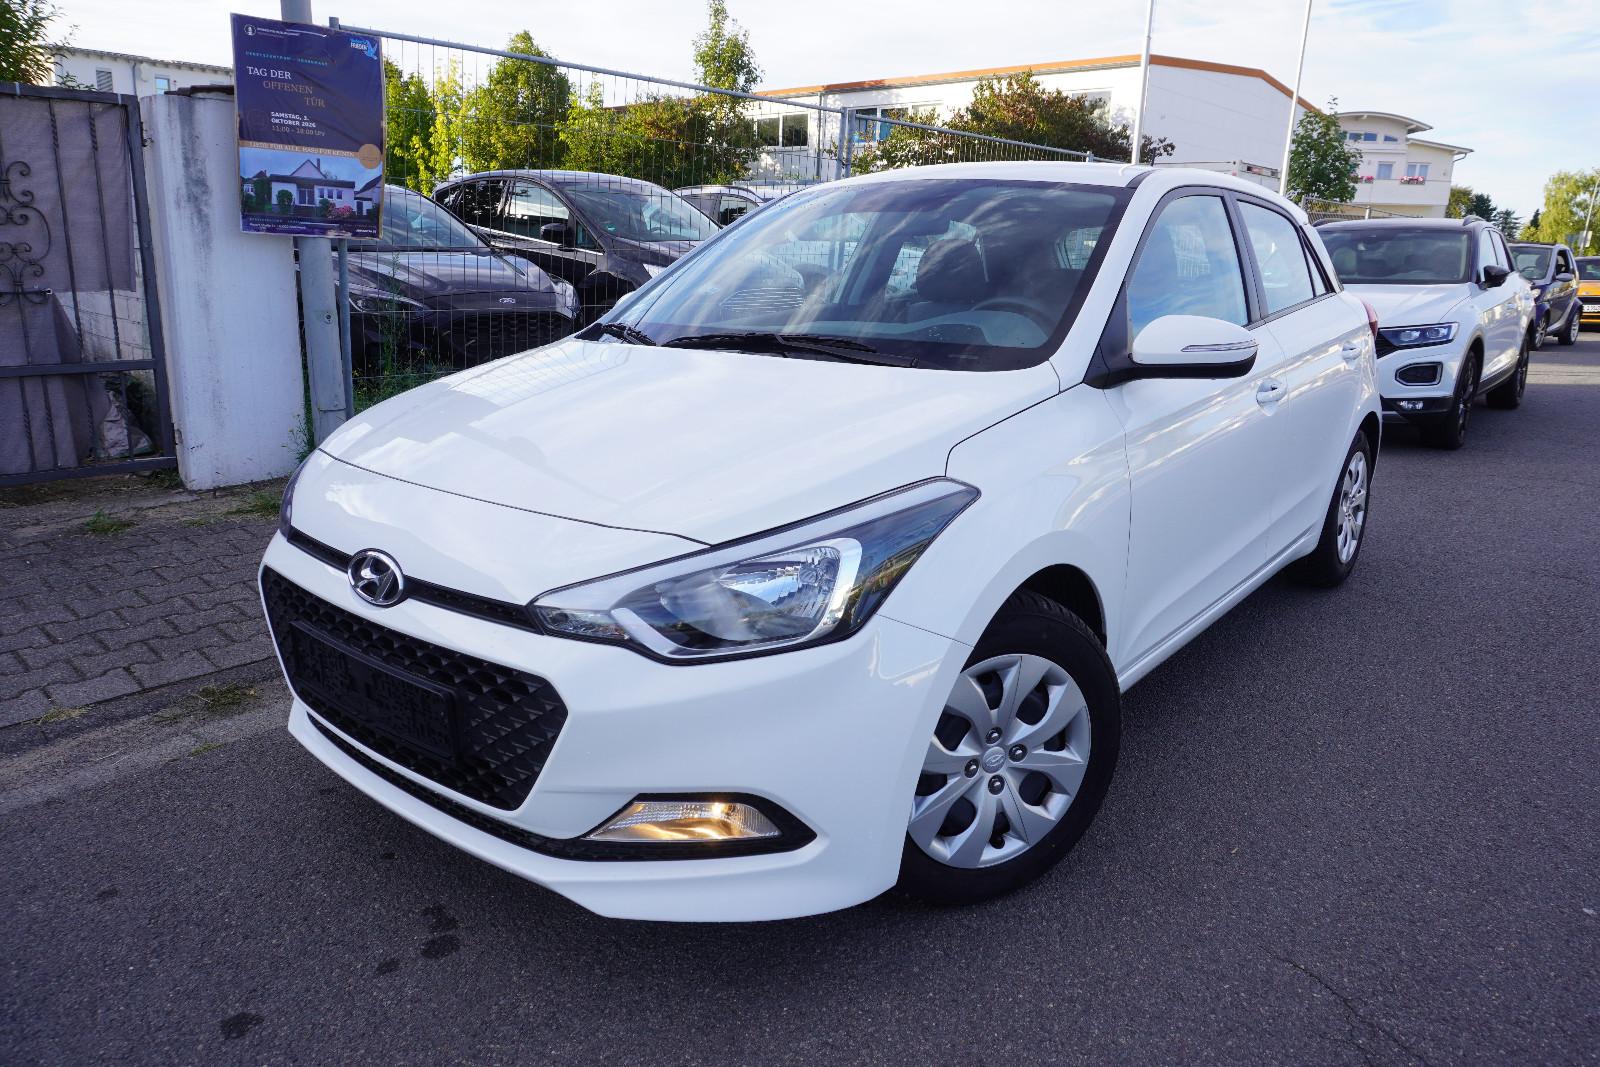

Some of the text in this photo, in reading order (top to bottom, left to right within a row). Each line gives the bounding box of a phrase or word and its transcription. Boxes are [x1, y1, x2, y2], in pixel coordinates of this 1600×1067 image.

[246, 66, 291, 80] TAG DER
[263, 80, 313, 94] OFFENEN
[304, 96, 325, 108] TÜR
[271, 117, 301, 126] OKTOBER
